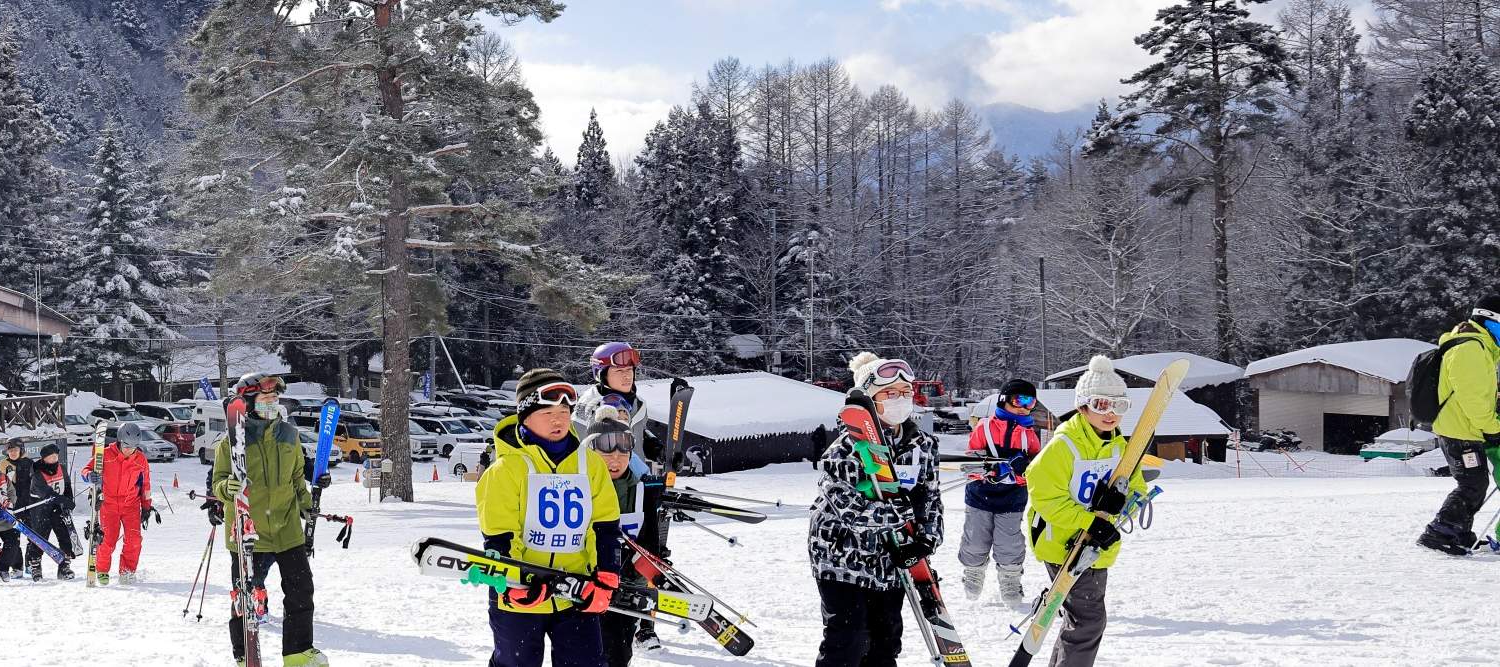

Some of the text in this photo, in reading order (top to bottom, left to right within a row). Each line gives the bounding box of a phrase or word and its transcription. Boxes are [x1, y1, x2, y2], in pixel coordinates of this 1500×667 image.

[538, 486, 584, 529] 66
[528, 530, 583, 547] 池田町
